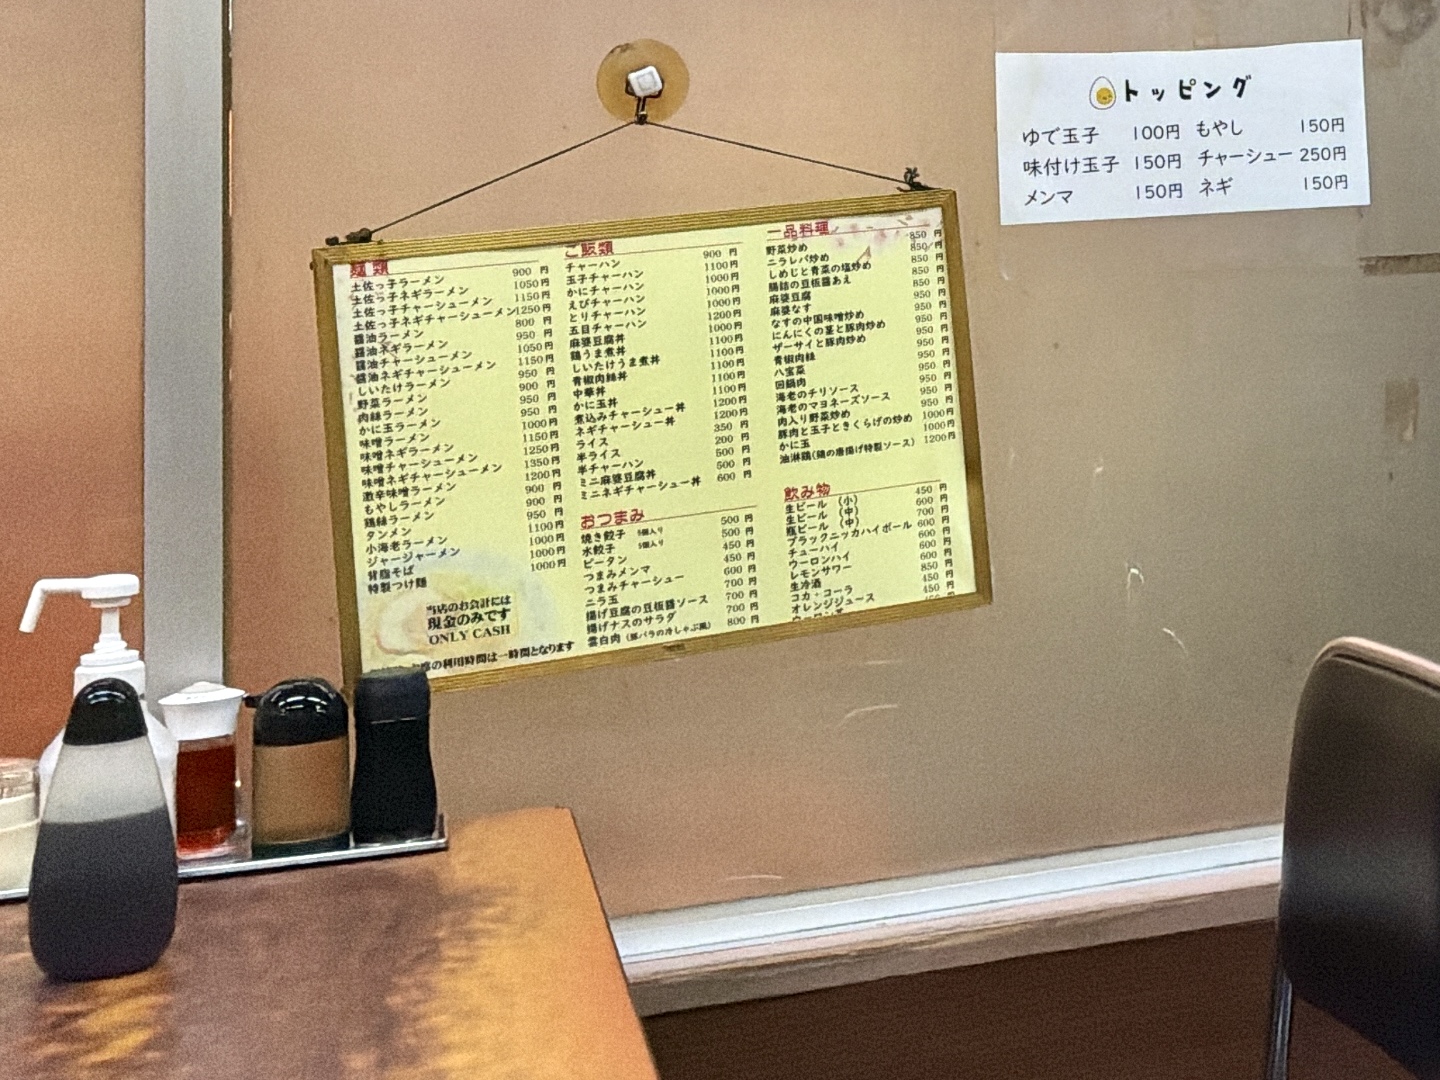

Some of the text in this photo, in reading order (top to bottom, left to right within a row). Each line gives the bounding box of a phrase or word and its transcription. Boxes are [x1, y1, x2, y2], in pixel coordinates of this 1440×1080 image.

[1125, 75, 1253, 102] トッピング
[1022, 117, 1345, 145] ゆで玉子 100円 もやし 150円
[1023, 146, 1347, 176] 味付け玉子 150円 チャーシュー 250円
[1025, 175, 1348, 206] メンマ 150円 ネギ 150円
[766, 220, 829, 240] 一品料理
[765, 242, 807, 256] 野菜炒め
[565, 257, 620, 272] チャーハン
[350, 273, 444, 294] 土佐っ子ラーメン
[512, 267, 531, 276] 900
[565, 268, 643, 285] 玉子チャーハン
[350, 284, 468, 307] 土佐っ子ネギラーメン
[566, 280, 644, 298] かにチャーハン
[351, 294, 492, 319] 土佐っ子チャーシューメン
[568, 292, 645, 310] えびチャーハン
[352, 305, 513, 332] 土佐っ子ネギチャーシューメン
[569, 305, 645, 323] とりチャーハン
[568, 317, 646, 336] 五目チャーハン
[357, 377, 450, 398] しいたけラーメン
[775, 383, 858, 402] 海老のチリソース
[357, 392, 427, 411] 野菜ラーメン
[573, 396, 618, 412] かに玉丼
[776, 391, 890, 415] 海老のマヨネーズソース
[358, 417, 440, 436] かに玉ラーメン
[574, 415, 675, 437] ネギチャーシュー丼
[359, 431, 429, 450] 味噌ラーメン
[575, 436, 608, 450] ライス
[576, 447, 620, 463] 半ライス
[714, 434, 733, 444] 200
[778, 438, 810, 451] かに玉
[359, 441, 454, 463] 味噌ネギラーメン
[360, 451, 477, 476] 味噌チャーシューメン
[576, 457, 643, 475] 半チャーハン
[361, 461, 502, 489] 味噌ネギチャーシューメン
[580, 475, 701, 500] ミニネギチャーシュー丼
[783, 481, 831, 501] 飲み物
[364, 495, 445, 515] もやしラーメン
[580, 507, 645, 529] おつまみ
[366, 525, 411, 541] タンメン
[787, 521, 912, 546] ブラックニッカハイボール
[365, 534, 447, 555] 小海老ラーメン
[787, 541, 838, 557] チューハイ
[366, 545, 460, 567] ジャージャーメン
[583, 553, 627, 569] ピータン
[788, 551, 849, 568] ウーロンハイ
[583, 564, 650, 582] つまみメンマ
[790, 561, 851, 579] レモンサワー
[584, 572, 684, 595] つまみチャーシュー
[585, 593, 618, 608] ニラ玉
[791, 591, 874, 612] オレンジジュース
[427, 606, 511, 631] 現金のみです
[428, 623, 510, 645] ONLY CASH
